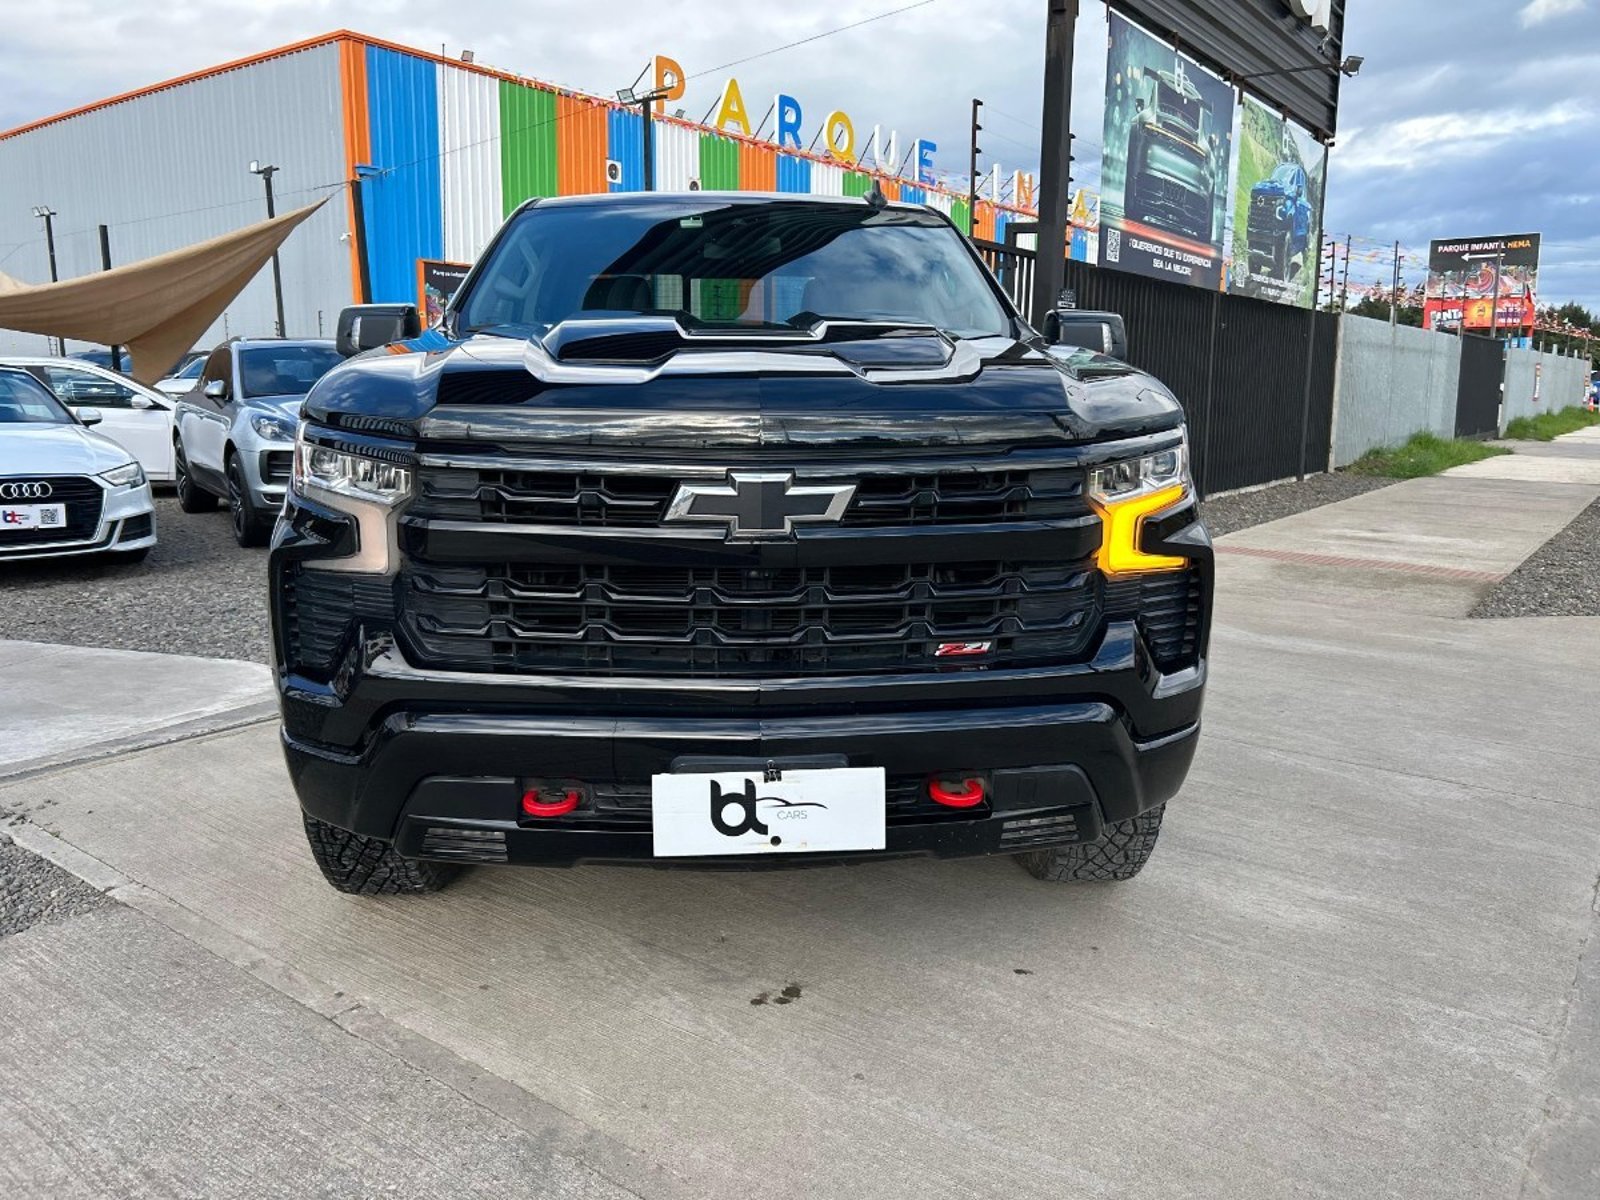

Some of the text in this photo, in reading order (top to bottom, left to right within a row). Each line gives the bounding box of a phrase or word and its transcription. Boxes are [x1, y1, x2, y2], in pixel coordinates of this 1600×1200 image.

[652, 55, 938, 188] PARQUE
[1438, 243, 1470, 253] PARQUE
[1470, 240, 1506, 251] INFANTL
[1152, 258, 1164, 269] SEA
[1165, 261, 1173, 271] LA
[777, 809, 808, 821] CARS
